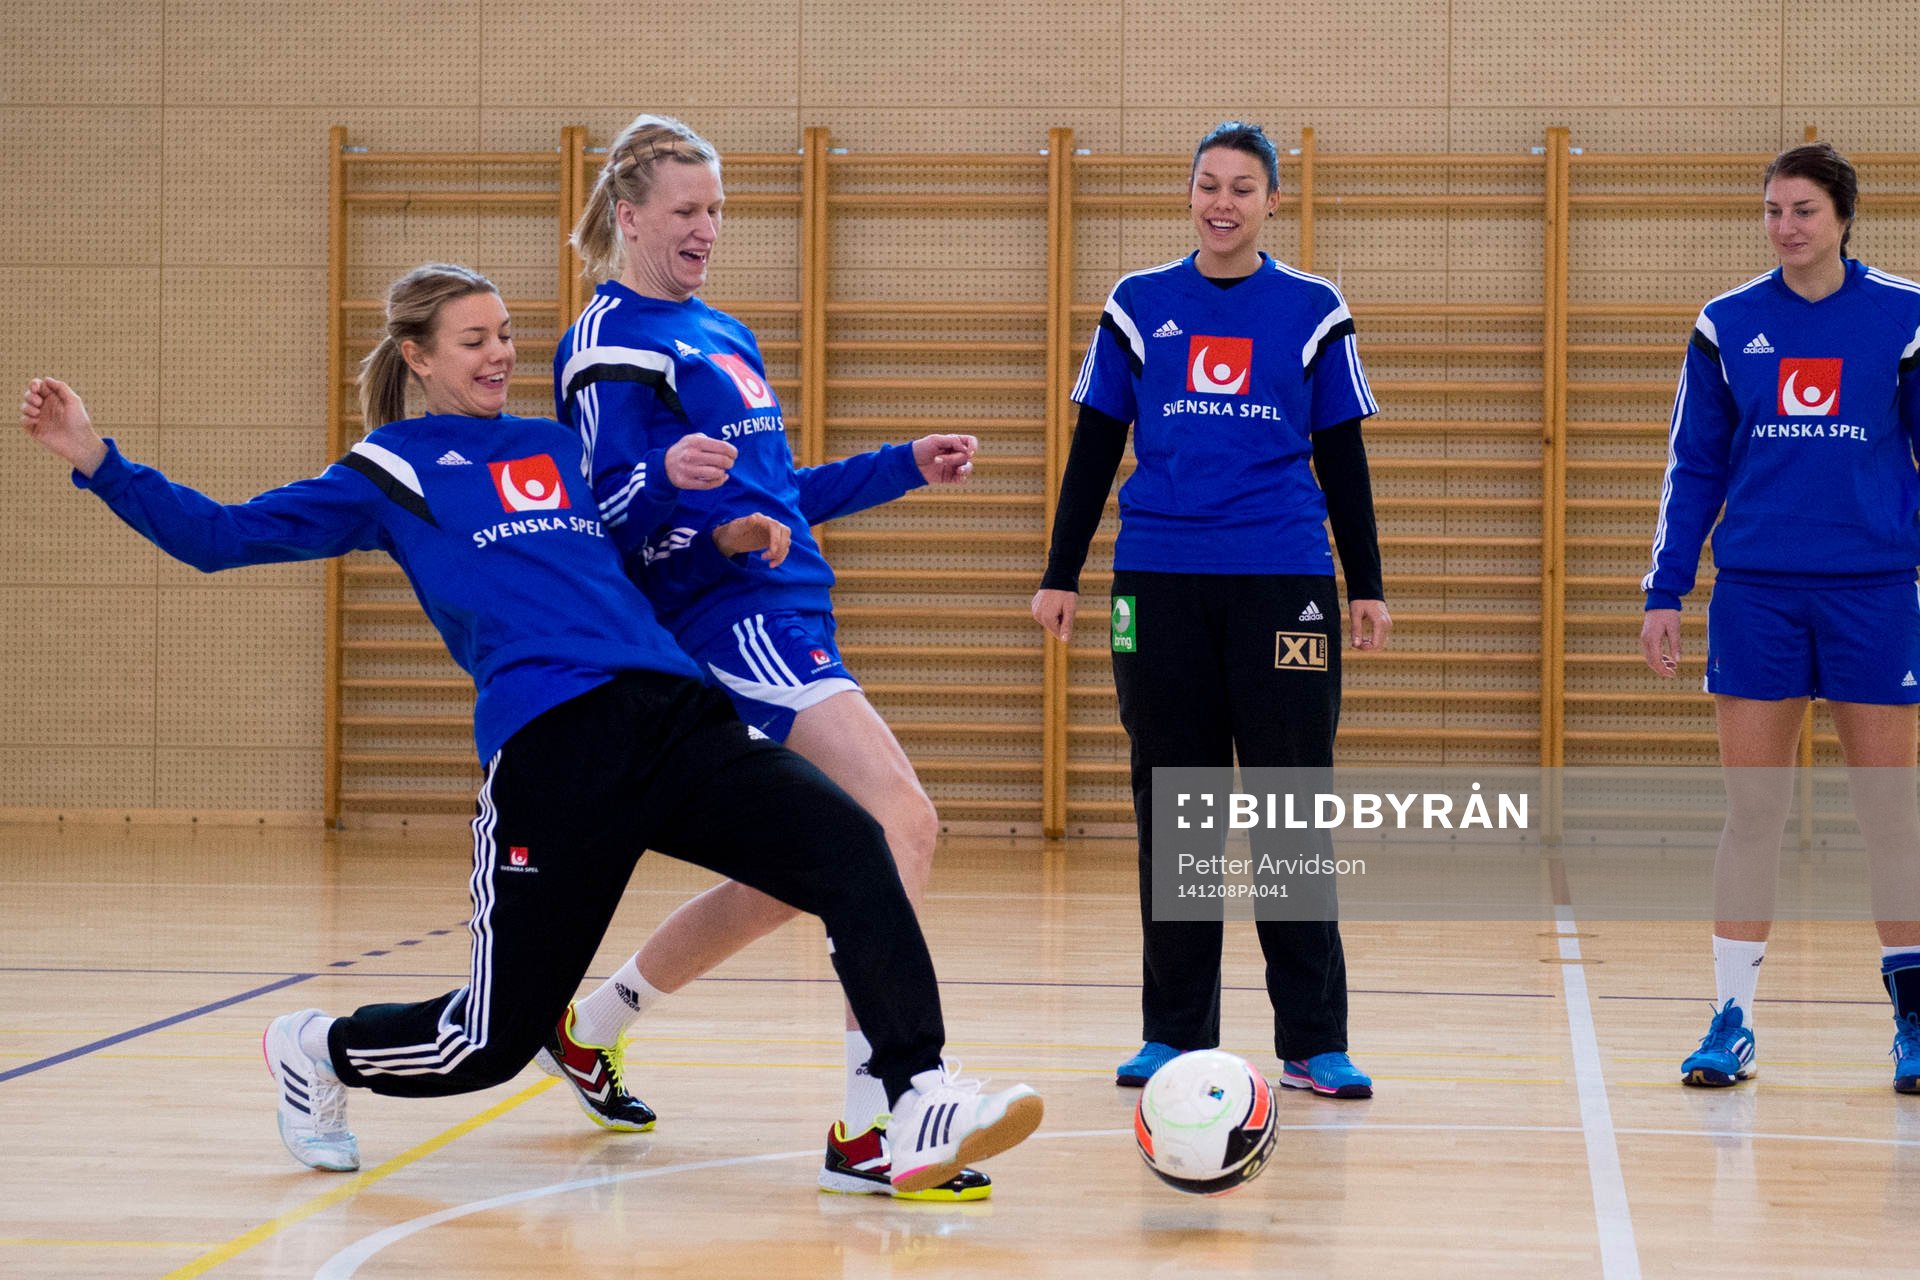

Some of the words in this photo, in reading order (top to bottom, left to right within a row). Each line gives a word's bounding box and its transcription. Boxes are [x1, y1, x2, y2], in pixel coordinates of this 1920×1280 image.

[1153, 329, 1183, 338] adidas
[1743, 346, 1775, 354] adidas
[1163, 400, 1234, 417] SVENSKA
[1239, 403, 1281, 421] SPEL
[721, 416, 776, 441] SVENSKA
[1829, 424, 1868, 441] SPEL
[472, 517, 567, 548] SVENSKA
[569, 516, 605, 538] SPEL
[1299, 613, 1324, 621] adidas
[1280, 636, 1325, 666] XL
